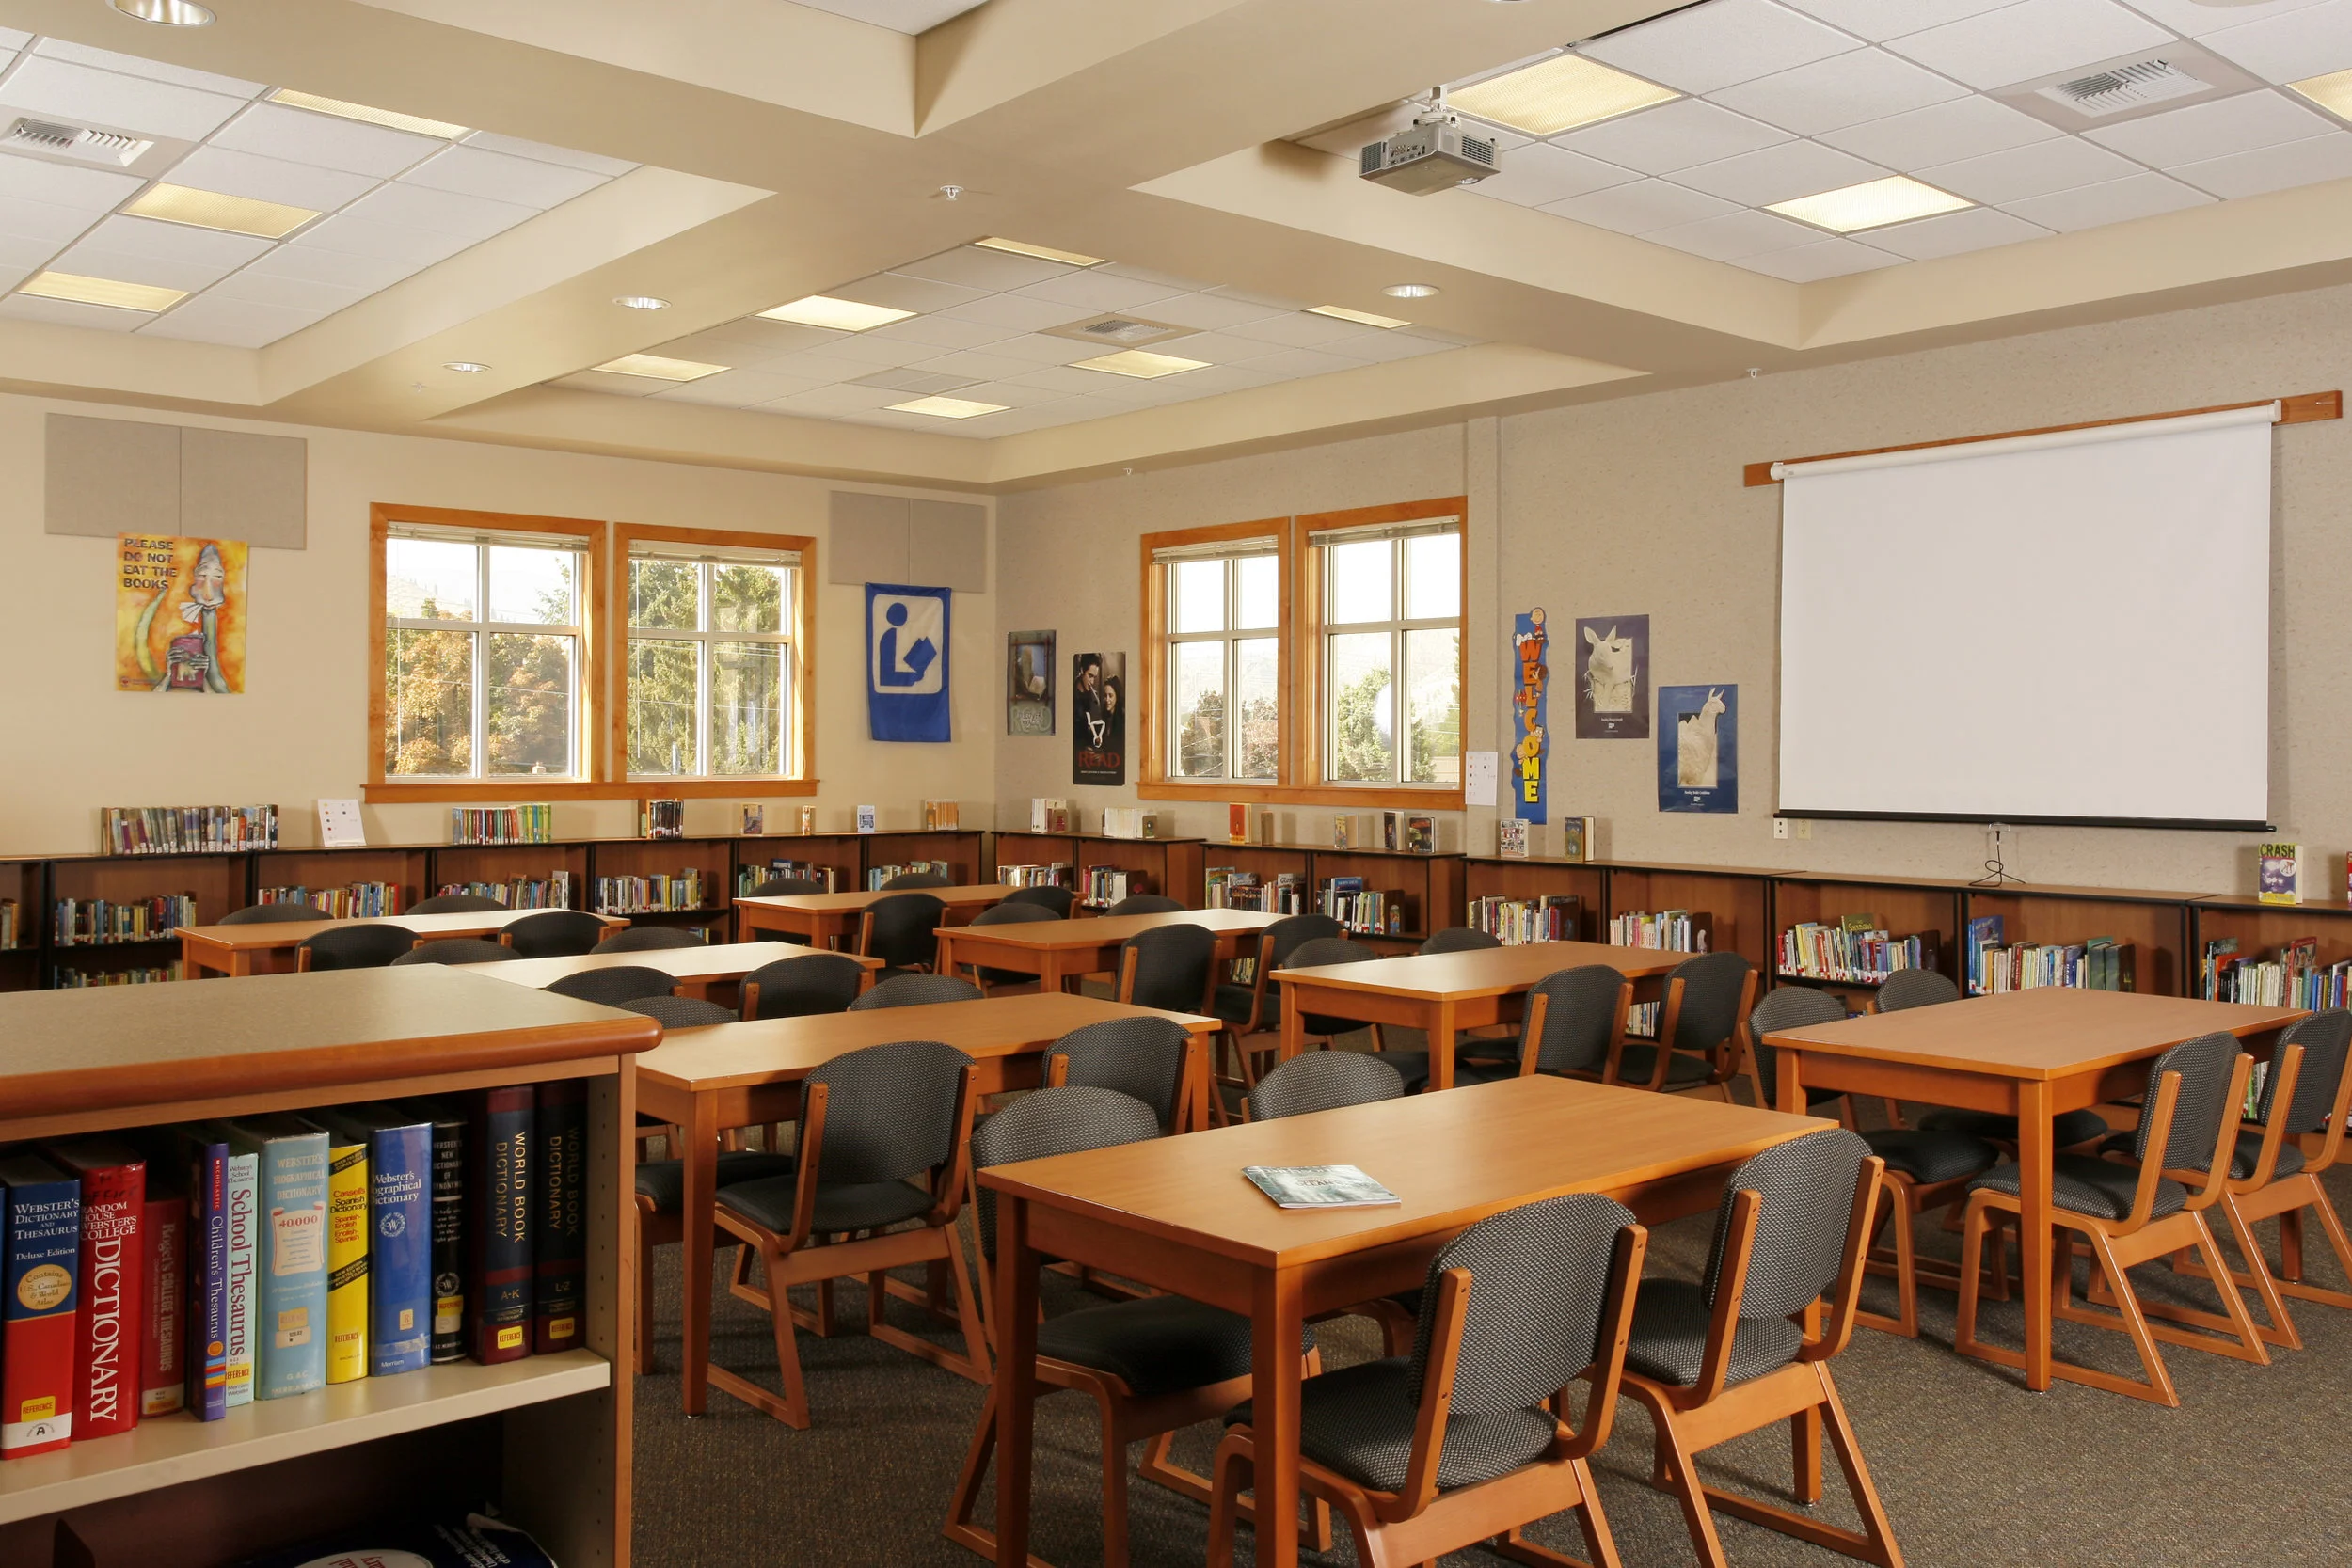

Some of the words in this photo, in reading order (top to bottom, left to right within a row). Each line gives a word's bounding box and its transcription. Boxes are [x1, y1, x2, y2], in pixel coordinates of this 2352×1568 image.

[124, 538, 174, 550] PLEASE
[123, 551, 143, 562] DO
[148, 553, 173, 563] NOT
[123, 565, 148, 575] EAT
[152, 566, 177, 577] THE
[123, 578, 168, 590] BOOKS
[1519, 640, 1541, 803] WELCOME
[1078, 750, 1120, 768] READ
[2260, 844, 2296, 858] CRASH
[277, 1154, 325, 1168] WEBSTER'S
[515, 1132, 525, 1190] WORLD
[567, 1126, 579, 1183] WORLD
[273, 1169, 326, 1184] BIOGRAPHICAL
[373, 1170, 415, 1183] Webster's
[549, 1136, 562, 1229] DICTIONARY
[277, 1185, 323, 1200] DICTIONARY
[373, 1179, 421, 1198] ographical
[496, 1142, 507, 1237] DICTIONARY
[15, 1197, 80, 1214] WEBSTER'S
[335, 1196, 365, 1207] Spanish
[376, 1192, 420, 1205] ictionary
[81, 1201, 127, 1214] RANDOM
[330, 1203, 369, 1213] Dictionary
[566, 1189, 578, 1236] BOOK
[15, 1210, 79, 1225] DICTIONARY
[81, 1211, 115, 1222] HOUSE
[231, 1189, 252, 1253] School
[515, 1196, 525, 1243] BOOK
[334, 1221, 358, 1229] English
[15, 1225, 78, 1240] THESAURUS
[80, 1224, 136, 1241] COLLEGE
[334, 1235, 360, 1243] Spanish
[211, 1215, 223, 1275] Children's
[16, 1251, 44, 1261] Deluxe
[47, 1247, 75, 1257] Edition
[25, 1271, 64, 1283] Contains
[39, 1289, 59, 1298] World
[161, 1272, 174, 1314] COLLEGE
[555, 1281, 572, 1292] L-Z
[501, 1289, 520, 1300] A-K
[211, 1277, 223, 1338] Thesaurus
[230, 1253, 252, 1356] Thesaurus
[90, 1237, 121, 1422] DICTIONARY
[160, 1315, 174, 1372] THESAURUS
[334, 1331, 359, 1343] REFERENCE
[499, 1331, 521, 1343] REFERENCE
[22, 1402, 54, 1415] REFERENCE
[36, 1426, 45, 1436] A
